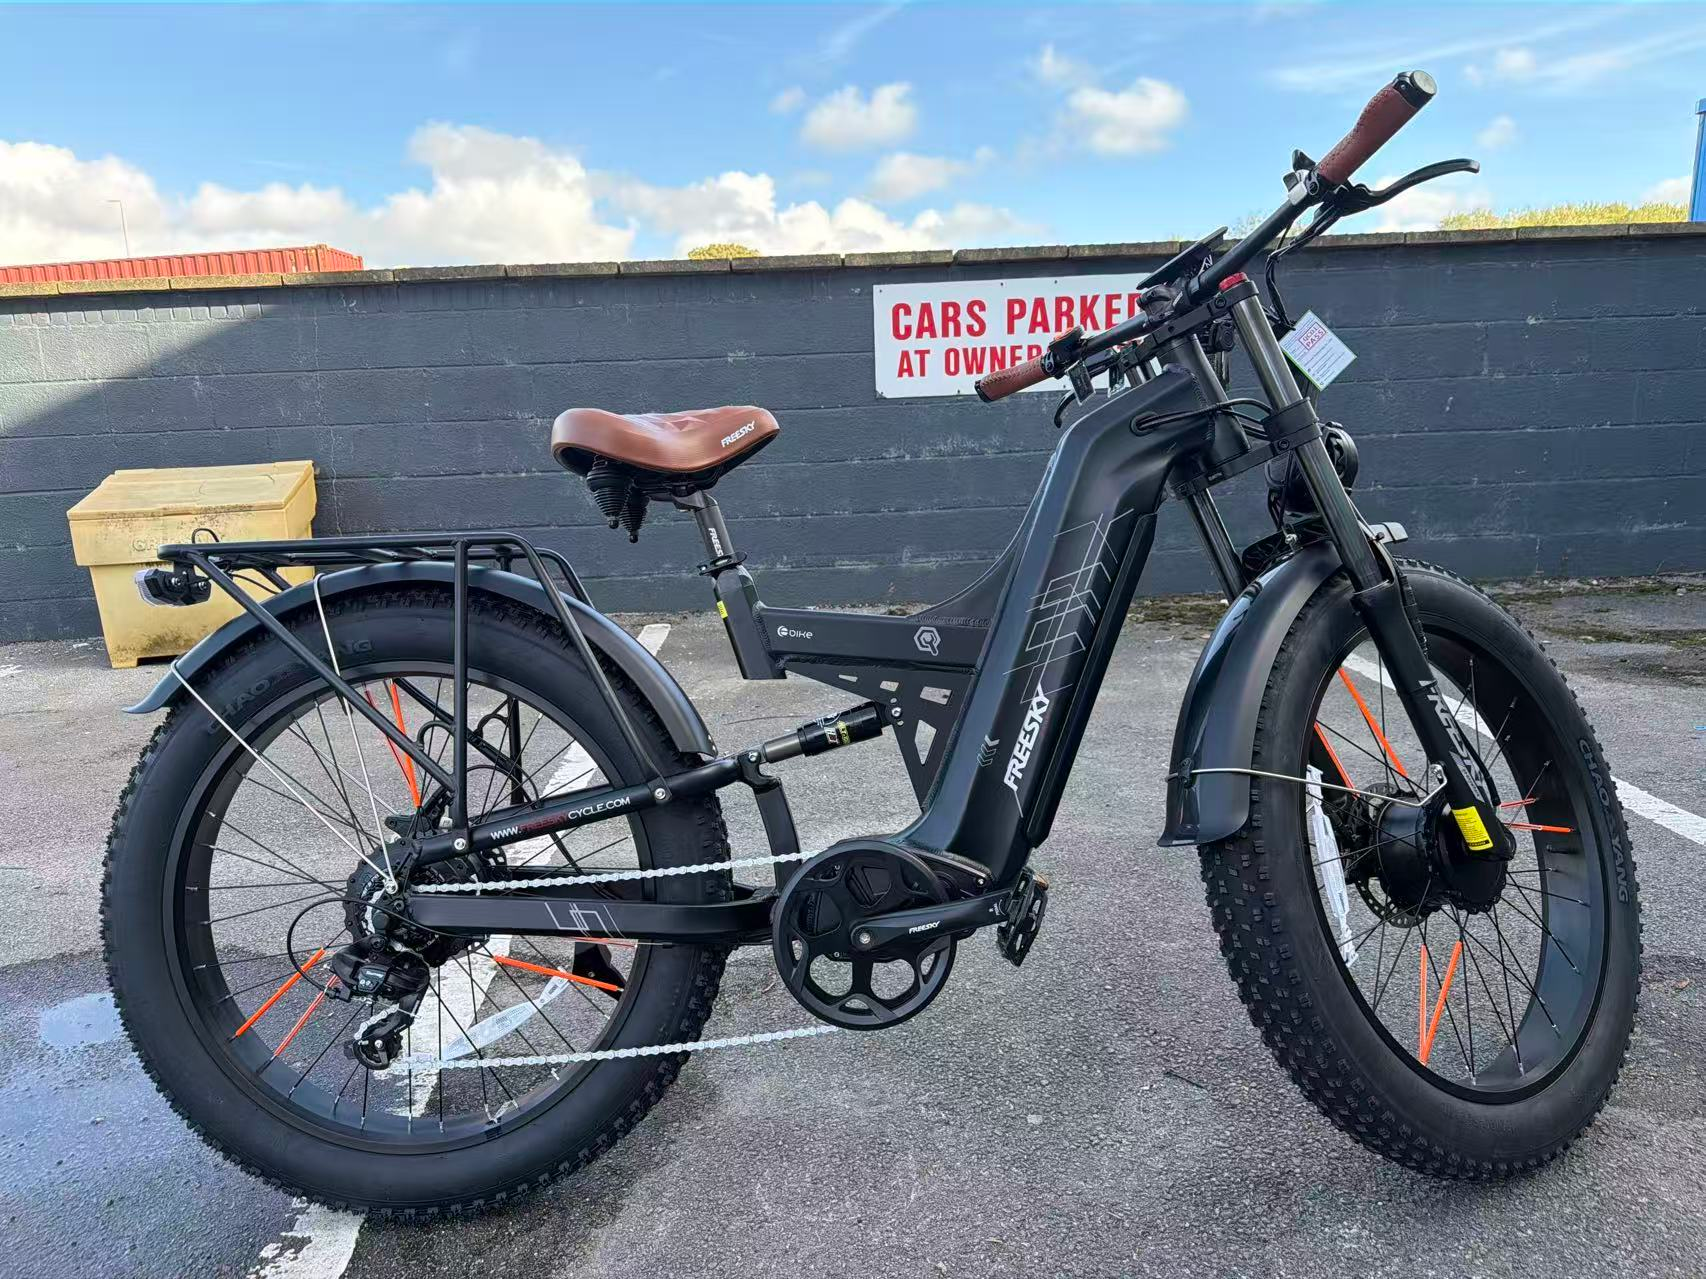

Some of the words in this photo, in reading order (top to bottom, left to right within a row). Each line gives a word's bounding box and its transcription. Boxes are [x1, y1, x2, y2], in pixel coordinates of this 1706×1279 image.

[891, 299, 987, 341] CARS
[1305, 329, 1324, 348] PASS
[897, 349, 931, 378] AT
[944, 344, 1051, 377] OWNER
[720, 420, 756, 448] FREESKY
[1003, 682, 1050, 792] FREESKY
[1579, 738, 1610, 807] CHAO
[1612, 834, 1630, 904] YANG
[908, 920, 941, 934] FREESKY
